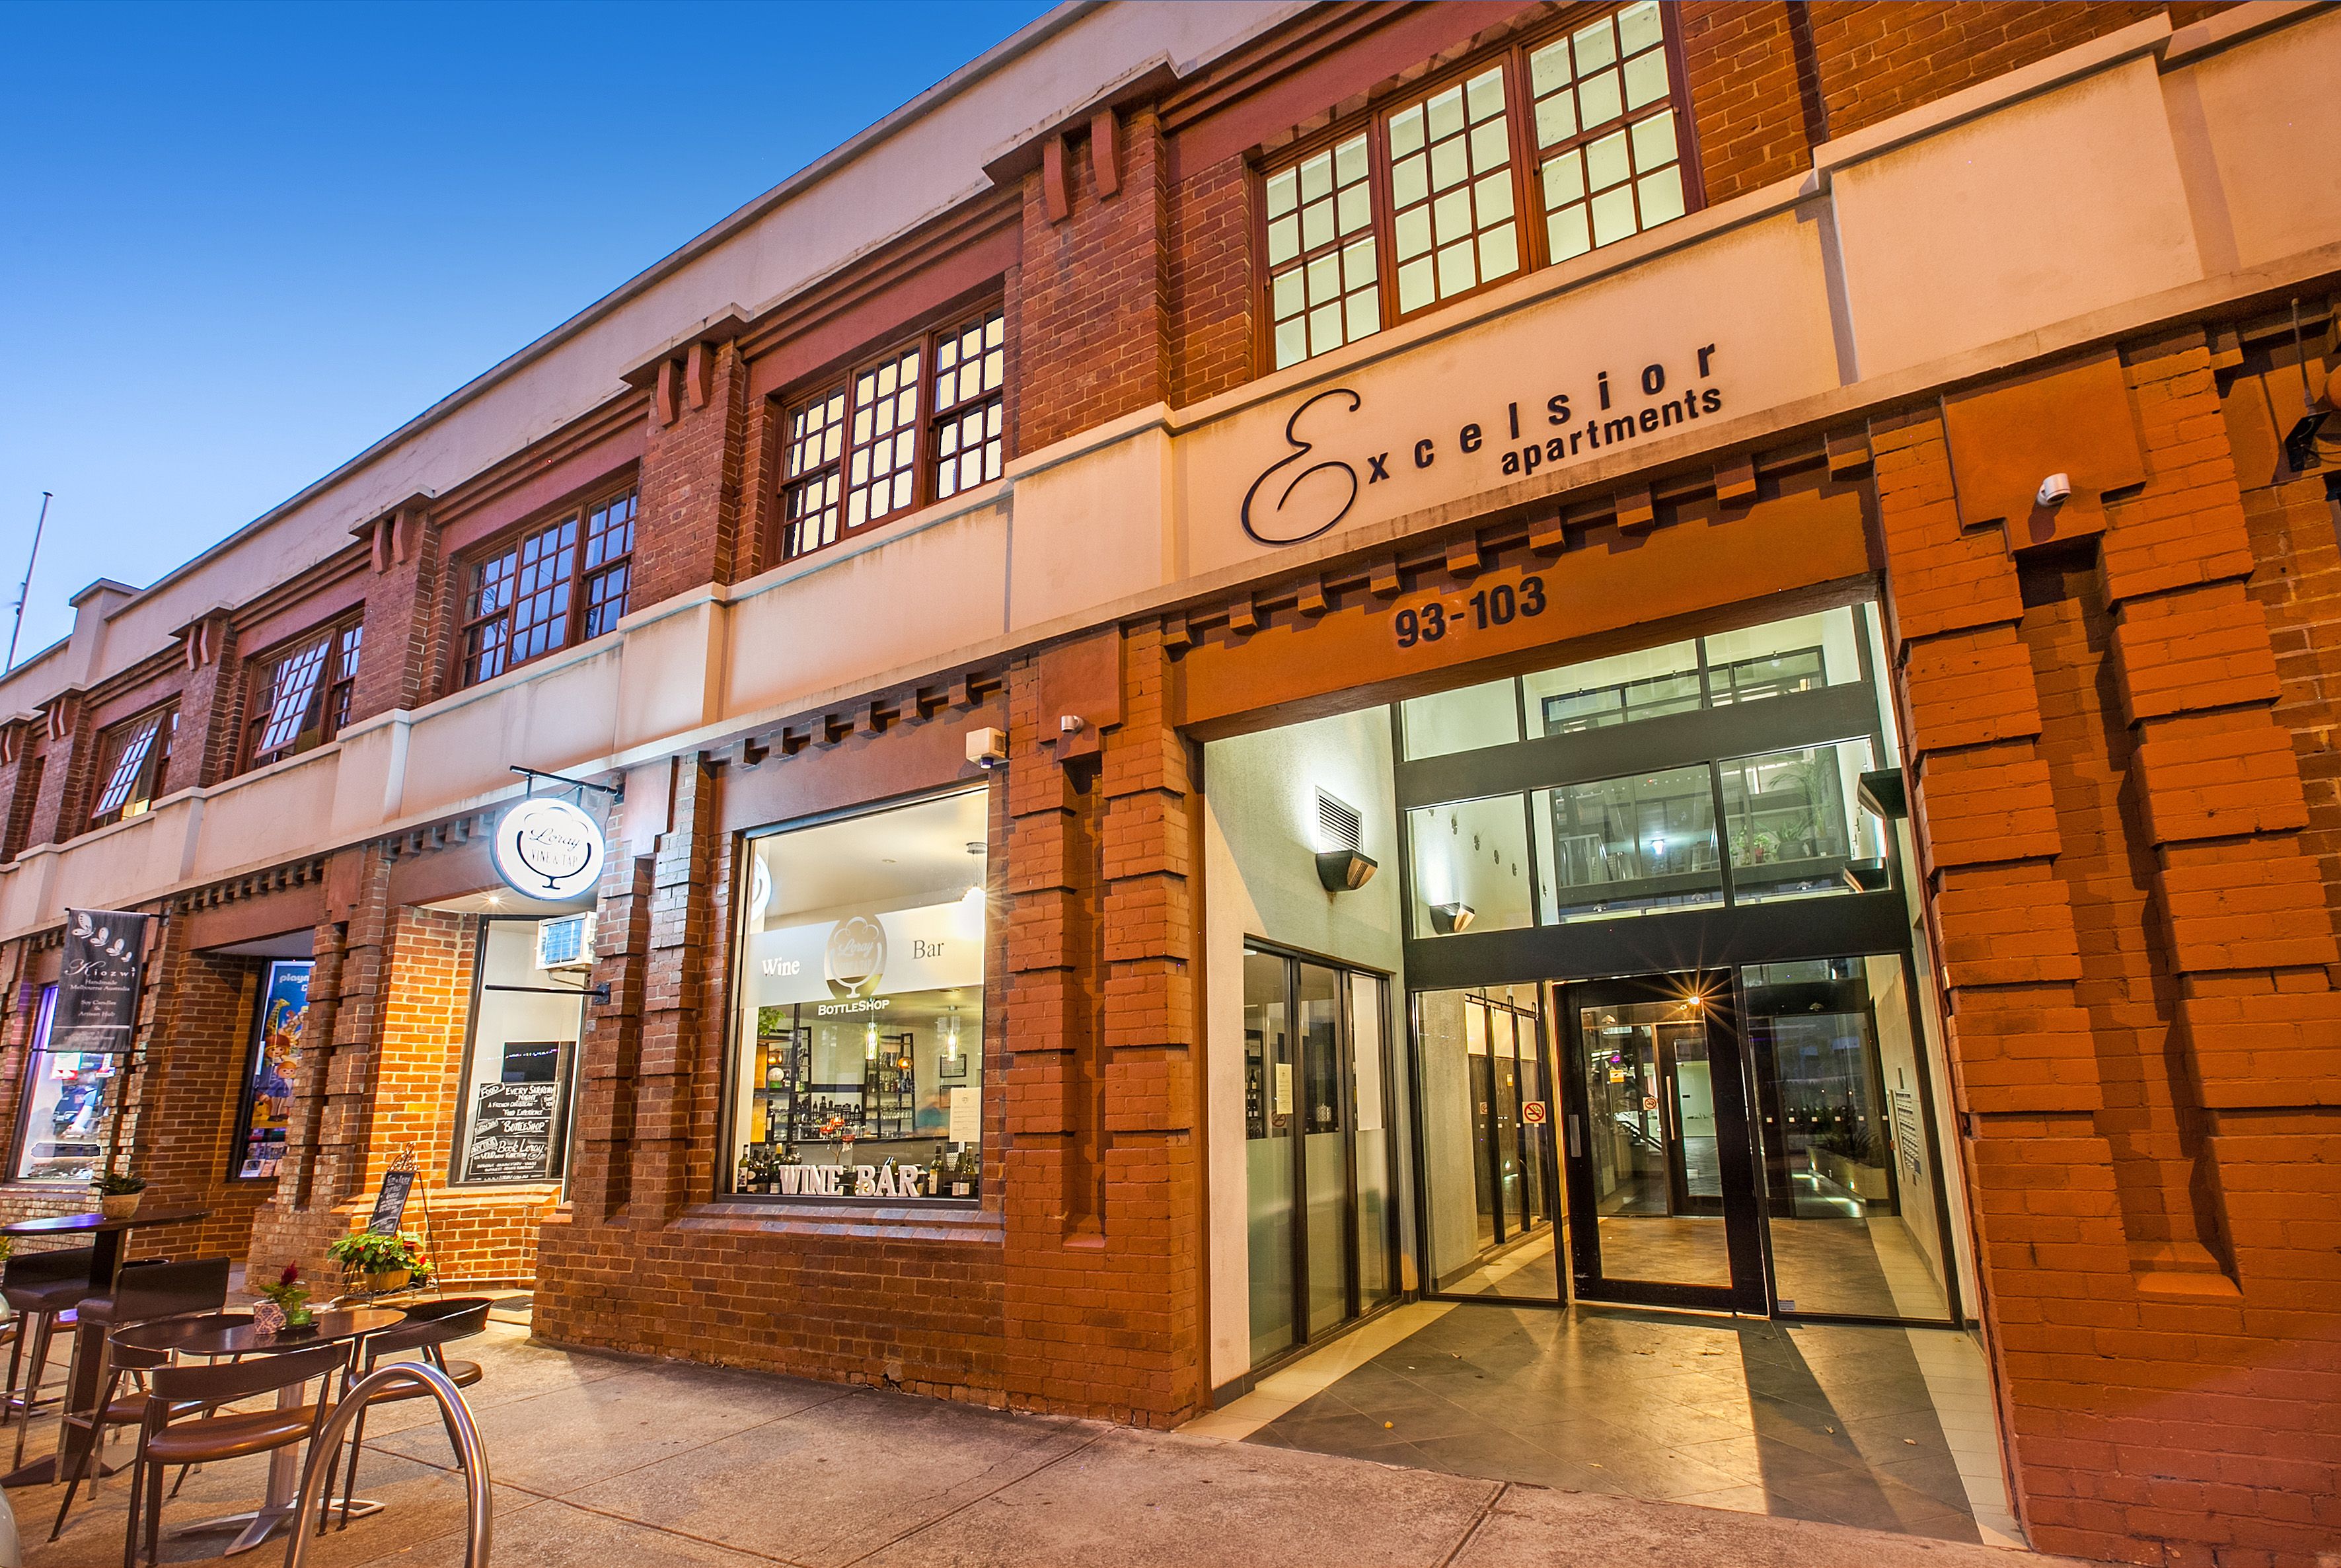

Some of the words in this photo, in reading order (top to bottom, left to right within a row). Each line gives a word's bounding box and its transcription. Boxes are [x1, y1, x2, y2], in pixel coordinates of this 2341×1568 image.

[1501, 388, 1722, 476] apartments
[1241, 343, 1716, 546] Excelsior
[1395, 576, 1547, 648] 93-103
[529, 828, 580, 852] Loray
[838, 938, 873, 957] Loray
[912, 940, 945, 959] Bar
[762, 957, 800, 977] Wine
[817, 999, 890, 1016] BOTTLESHOP
[480, 1086, 500, 1097] FOOD
[778, 1165, 844, 1196] WINE
[856, 1165, 920, 1197] BAR
